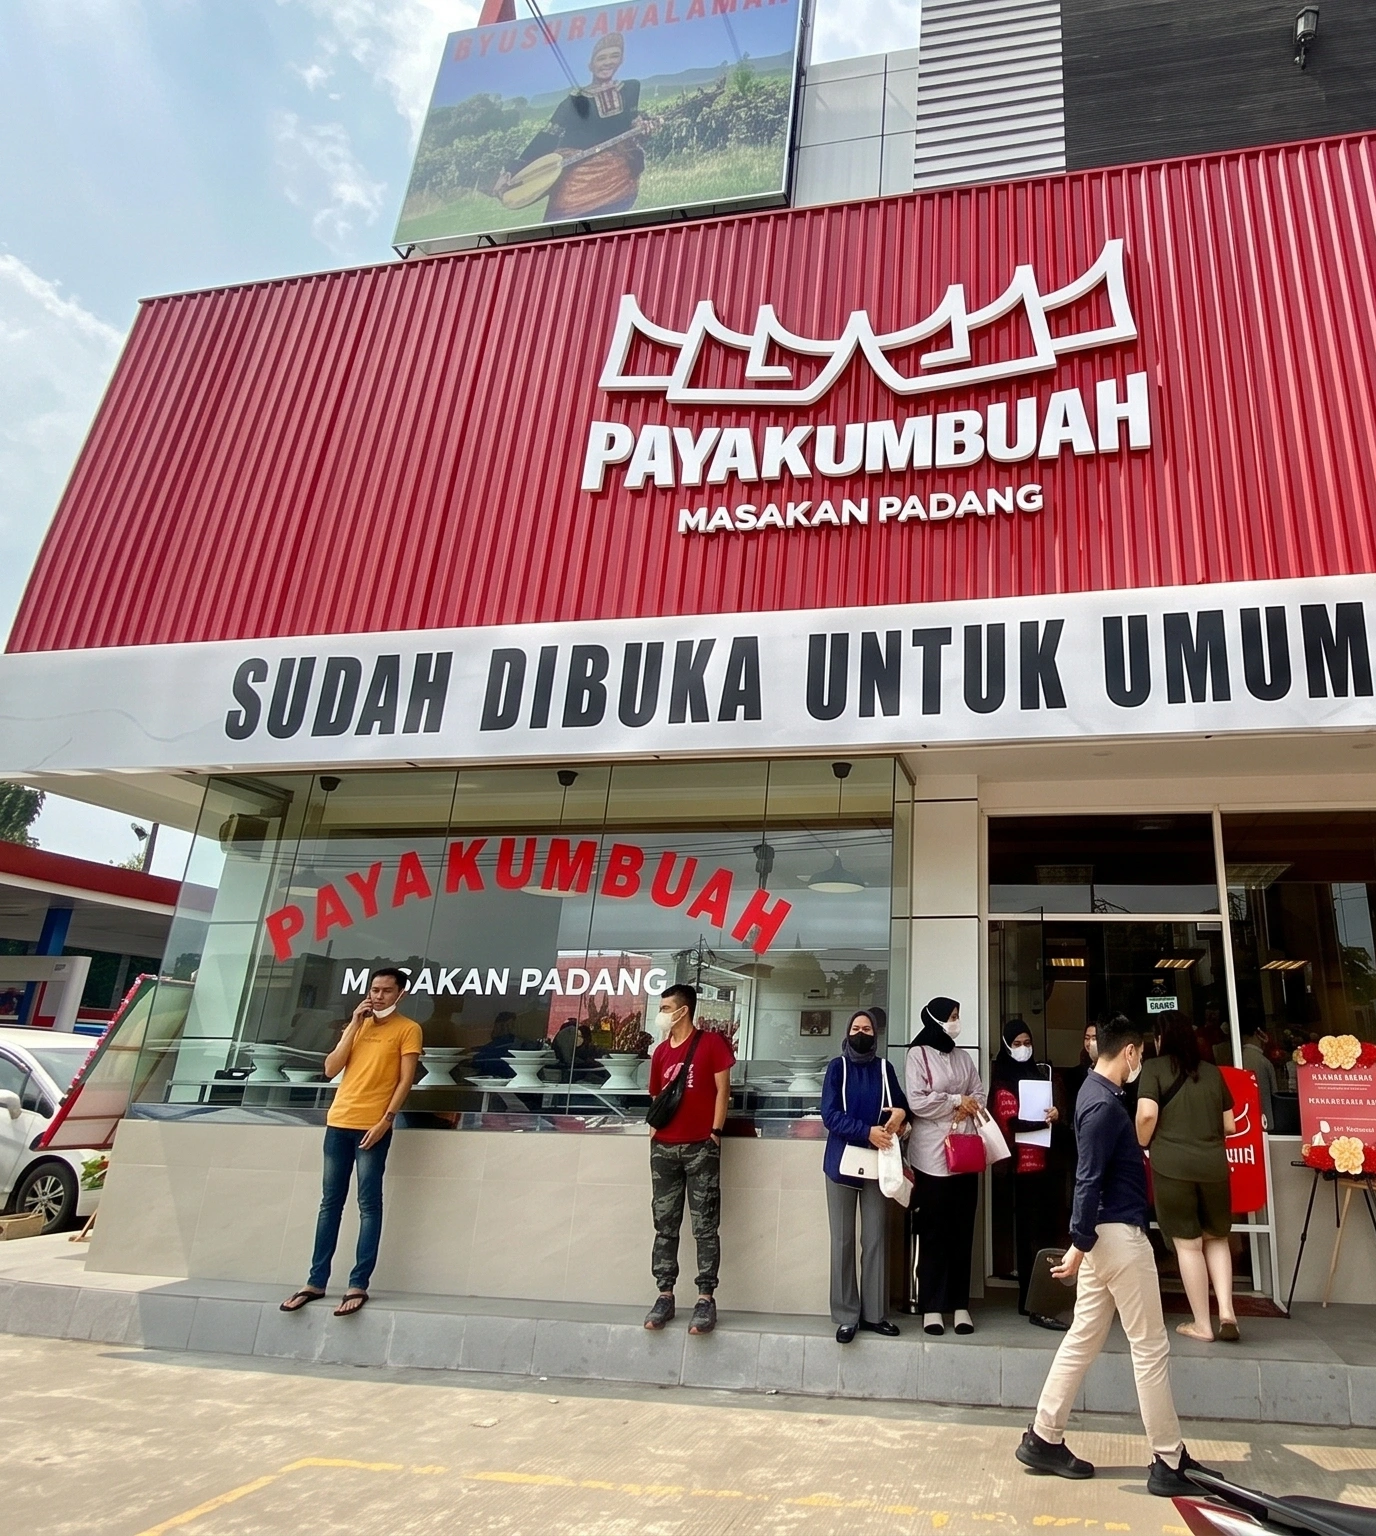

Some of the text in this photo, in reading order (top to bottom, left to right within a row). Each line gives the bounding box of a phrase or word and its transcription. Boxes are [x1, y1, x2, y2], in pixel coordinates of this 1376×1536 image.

[581, 371, 1152, 492] PAYAKUMBUAH
[677, 483, 1044, 535] MASAKAN PADANG
[225, 601, 1375, 741] SUDAH DIBUKA UNTUK UMUM
[265, 837, 792, 963] PAYAKUMBUAH
[341, 967, 667, 996] MSAKAN PADANG
